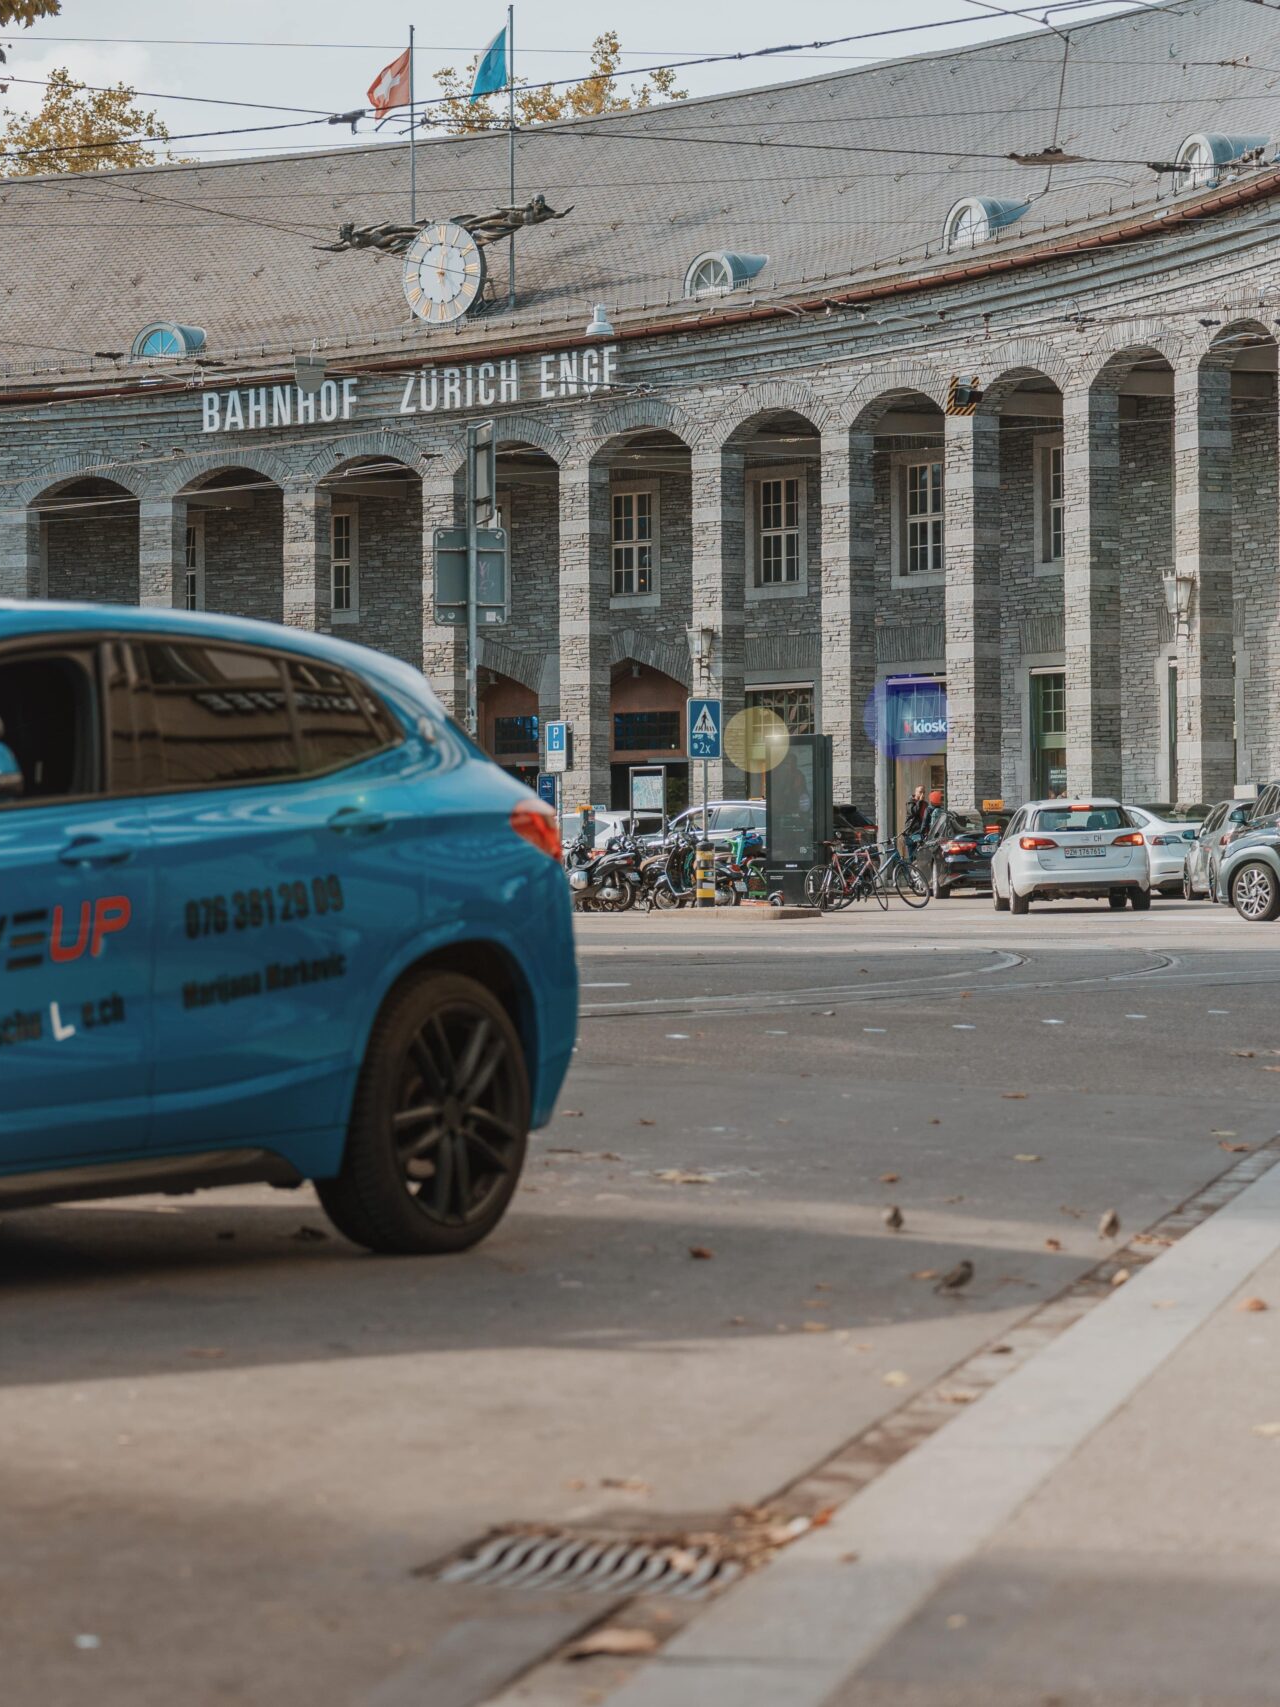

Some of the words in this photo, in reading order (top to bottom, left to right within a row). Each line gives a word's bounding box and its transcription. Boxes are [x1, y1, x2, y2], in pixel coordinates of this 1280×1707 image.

[202, 377, 359, 433] BAHNHOF
[540, 345, 618, 399] ENGE
[913, 719, 947, 734] kiosk
[699, 741, 711, 754] 2x
